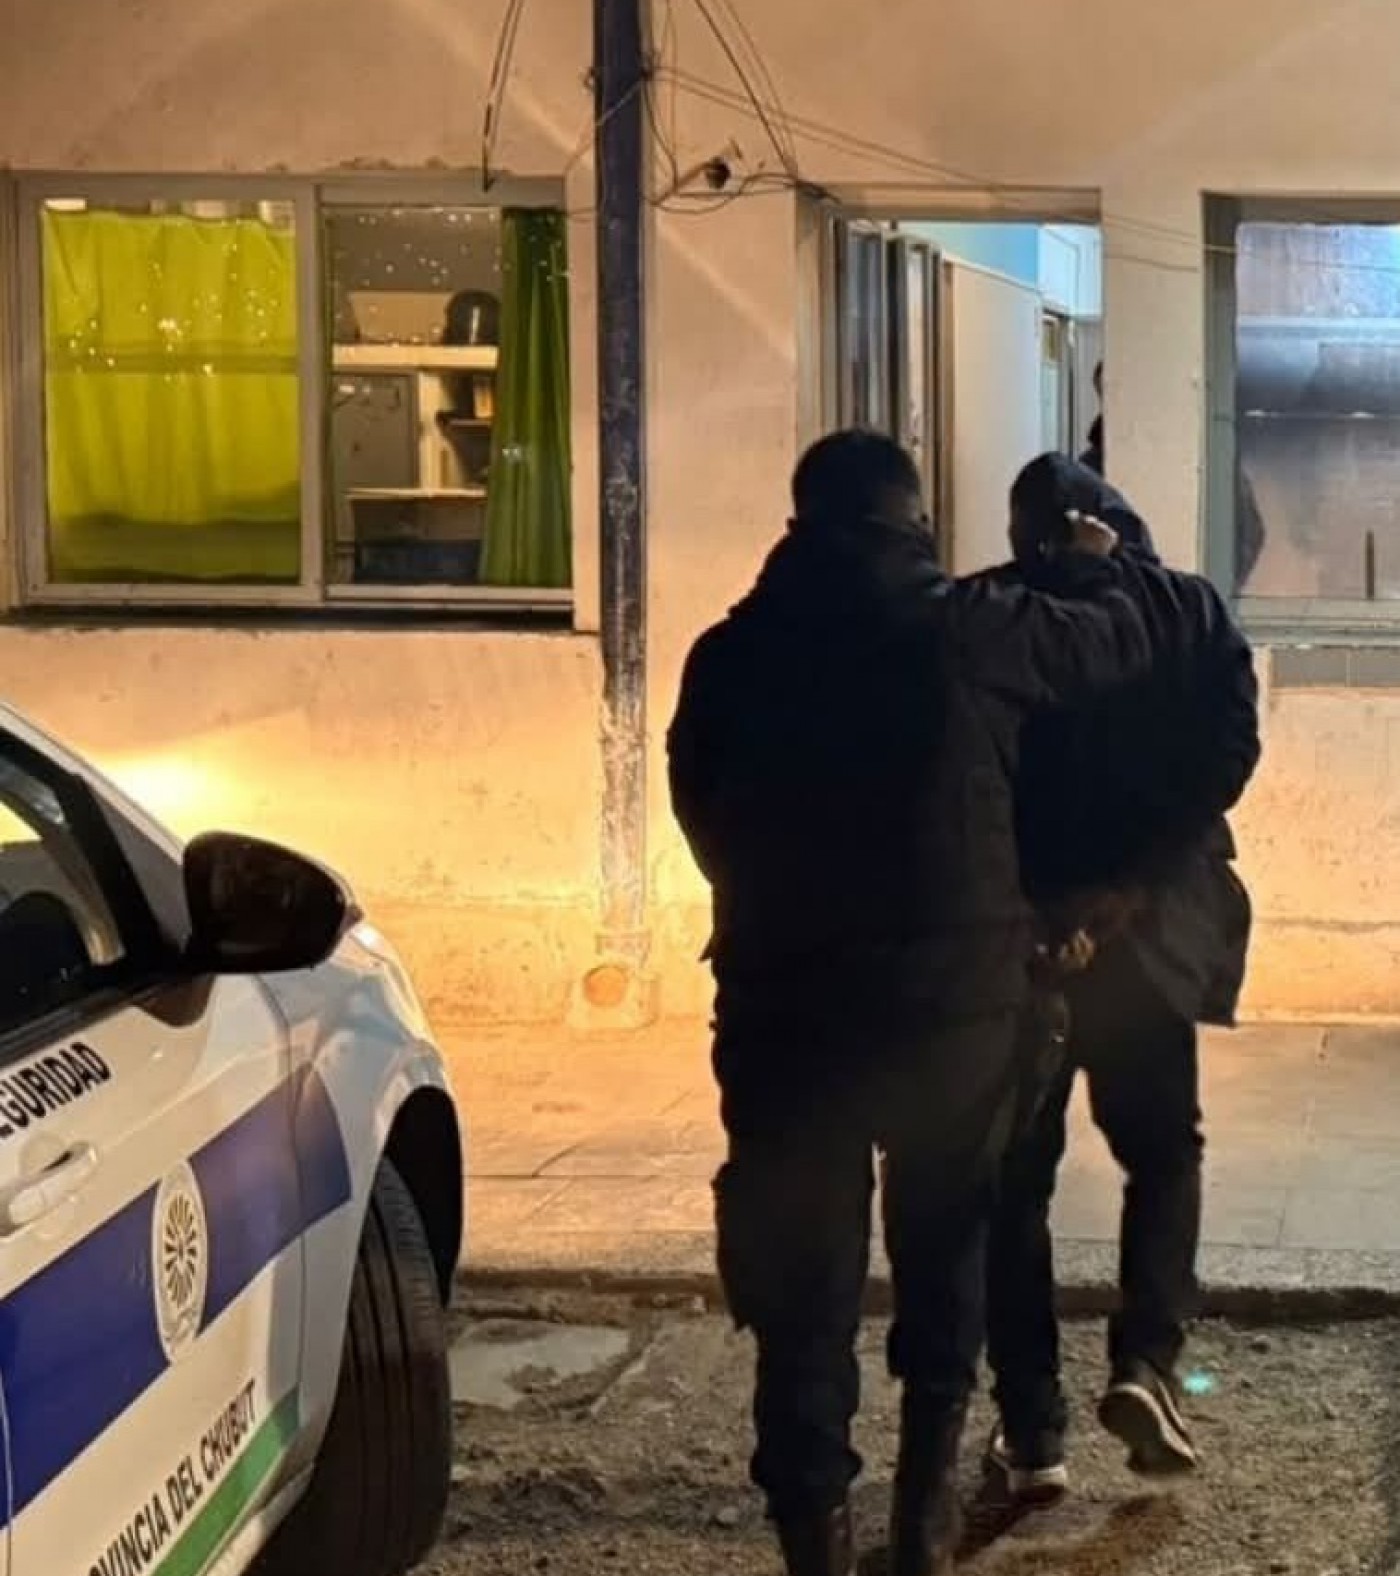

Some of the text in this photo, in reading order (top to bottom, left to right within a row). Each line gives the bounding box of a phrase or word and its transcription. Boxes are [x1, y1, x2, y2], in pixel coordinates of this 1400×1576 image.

[0, 1042, 111, 1138] GURIDAD
[89, 1378, 256, 1576] VINCIA DEL CHUBUT
